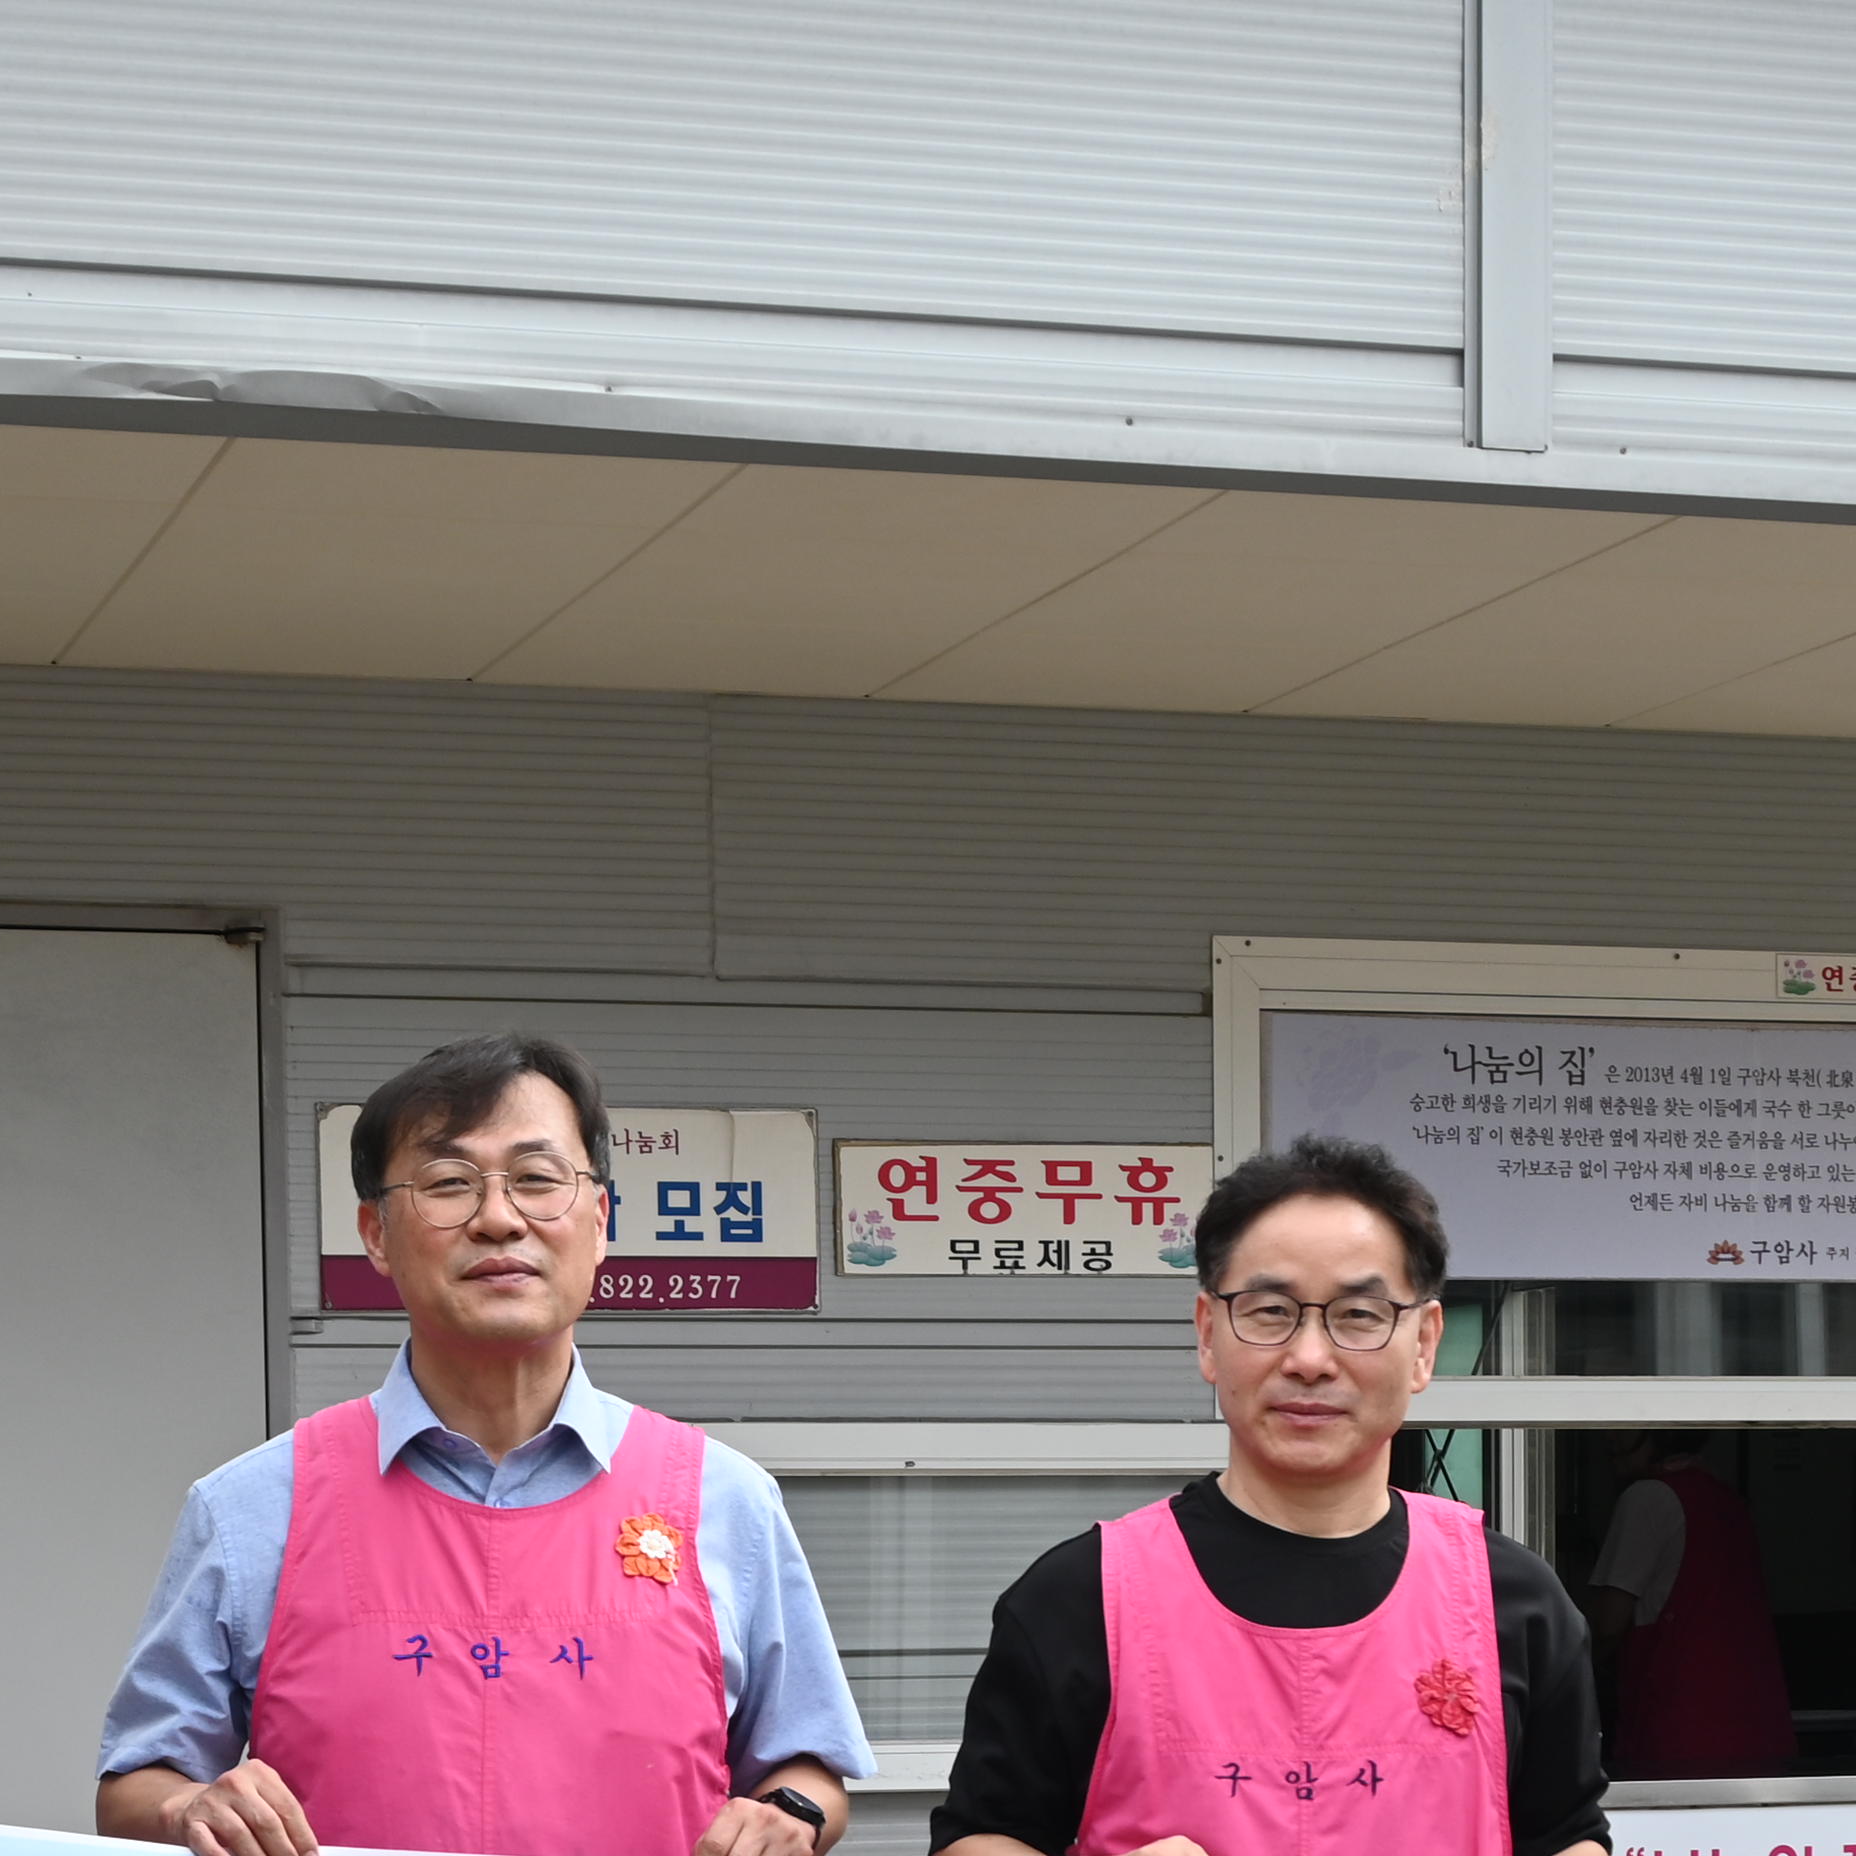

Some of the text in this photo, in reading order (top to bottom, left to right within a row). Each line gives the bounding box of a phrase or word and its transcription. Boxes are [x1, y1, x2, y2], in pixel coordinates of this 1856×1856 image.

[1604, 1065, 1621, 1083] 은
[1625, 1066, 1675, 1084] 2013년
[1680, 1066, 1703, 1085] 4월
[1710, 1067, 1731, 1086] 1일
[1737, 1067, 1782, 1087] 구암사
[1409, 1093, 1457, 1112] 숭고한
[1461, 1094, 1508, 1113] 희생을
[1512, 1095, 1556, 1114] 기리기
[1563, 1096, 1593, 1115] 위해
[1599, 1096, 1659, 1116] 현충원을
[1664, 1097, 1694, 1117] 찾는
[1699, 1098, 1757, 1118] 이들에게
[1762, 1100, 1792, 1119] 국수
[1797, 1100, 1813, 1119] 한
[611, 1128, 679, 1155] 나눔회
[1489, 1126, 1503, 1146] 이
[1509, 1126, 1554, 1146] 현충원
[1559, 1127, 1605, 1147] 봉안관
[1610, 1128, 1638, 1148] 옆에
[1644, 1128, 1688, 1148] 자리한
[1693, 1129, 1723, 1149] 것은
[1726, 1131, 1786, 1150] 즐거움을
[1790, 1131, 1820, 1150] 서로
[1497, 1158, 1573, 1178] 국가보조금
[1579, 1160, 1607, 1179] 없이
[1613, 1160, 1659, 1180] 구암사
[1663, 1161, 1692, 1180] 자체
[1699, 1161, 1757, 1181] 비용으로
[1762, 1162, 1820, 1182] 운영하고
[1827, 1163, 1856, 1182] 있는
[878, 1156, 1181, 1225] 연중무휴
[1629, 1192, 1674, 1212] 언제든
[1678, 1193, 1707, 1212] 자비
[1714, 1193, 1758, 1213] 나눔을
[1763, 1194, 1792, 1213] 함께
[1797, 1194, 1812, 1213] 할
[656, 1181, 763, 1242] 모집
[948, 1239, 1114, 1273] 무료제공
[1749, 1240, 1818, 1265] 구암사
